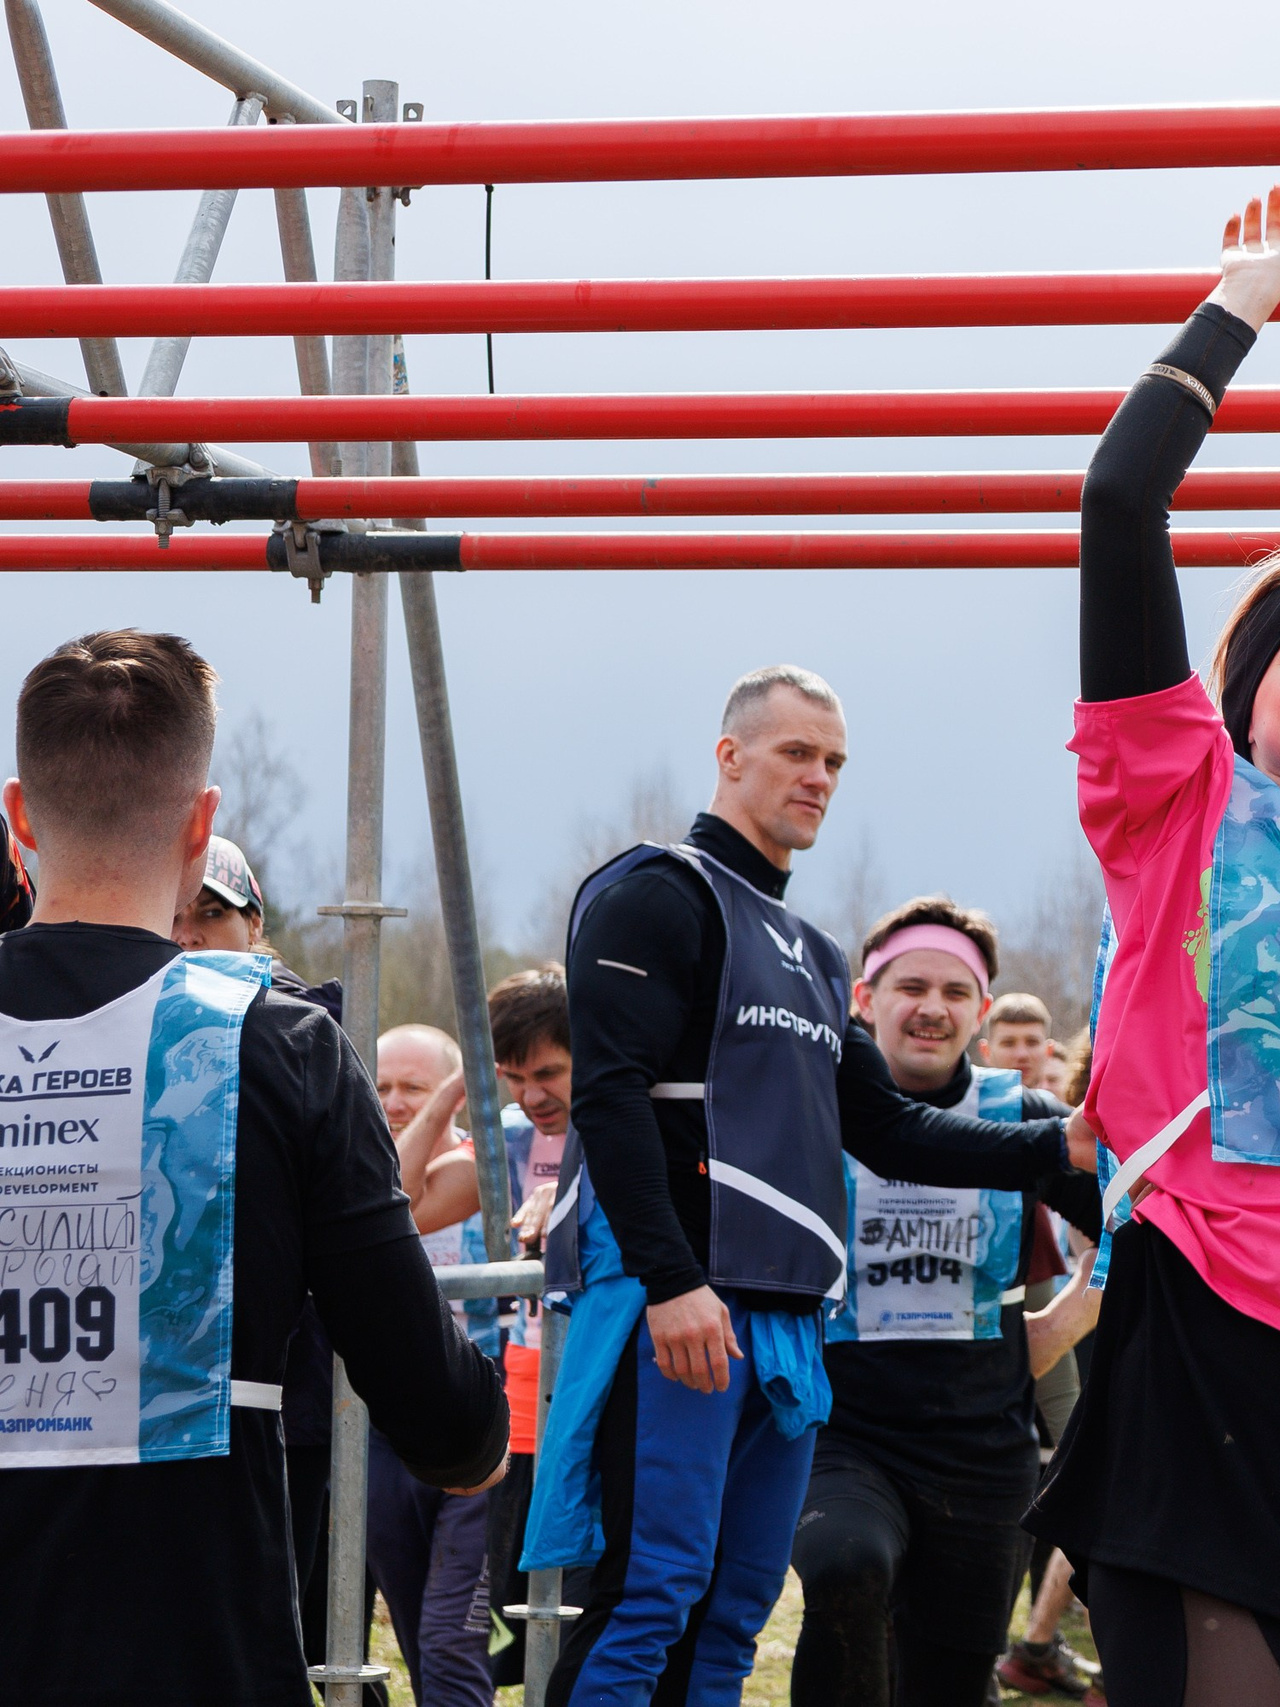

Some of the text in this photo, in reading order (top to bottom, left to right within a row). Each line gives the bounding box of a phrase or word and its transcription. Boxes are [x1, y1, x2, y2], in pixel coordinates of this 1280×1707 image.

[1184, 376, 1214, 410] Sminex
[32, 1067, 132, 1092] ГЕРОЕВ
[0, 1114, 100, 1147] minex
[0, 1286, 116, 1364] 409
